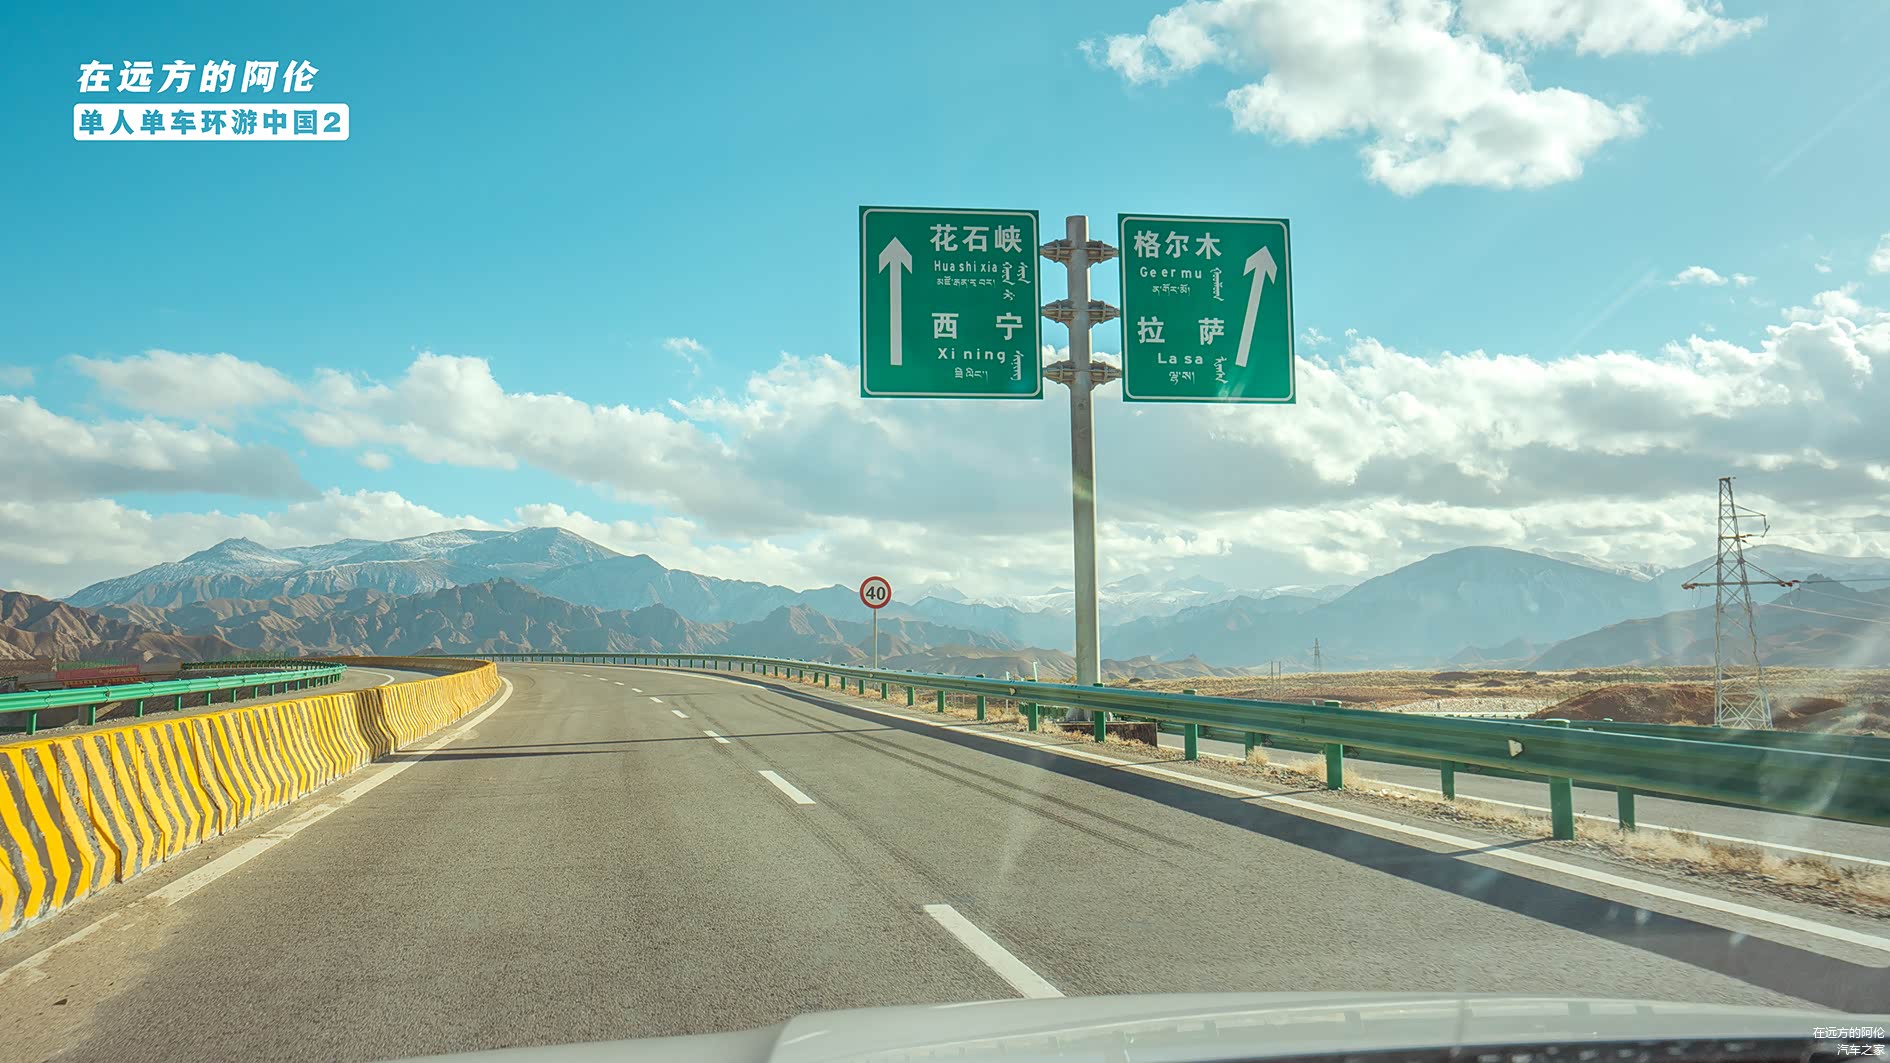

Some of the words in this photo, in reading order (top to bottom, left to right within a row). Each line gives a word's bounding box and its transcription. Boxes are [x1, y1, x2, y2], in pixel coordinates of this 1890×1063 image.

[930, 224, 1023, 253] 花石峡
[1134, 230, 1222, 260] 格尔木
[931, 312, 1023, 341] 西宁
[1137, 316, 1225, 346] 拉萨
[866, 586, 886, 601] 40
